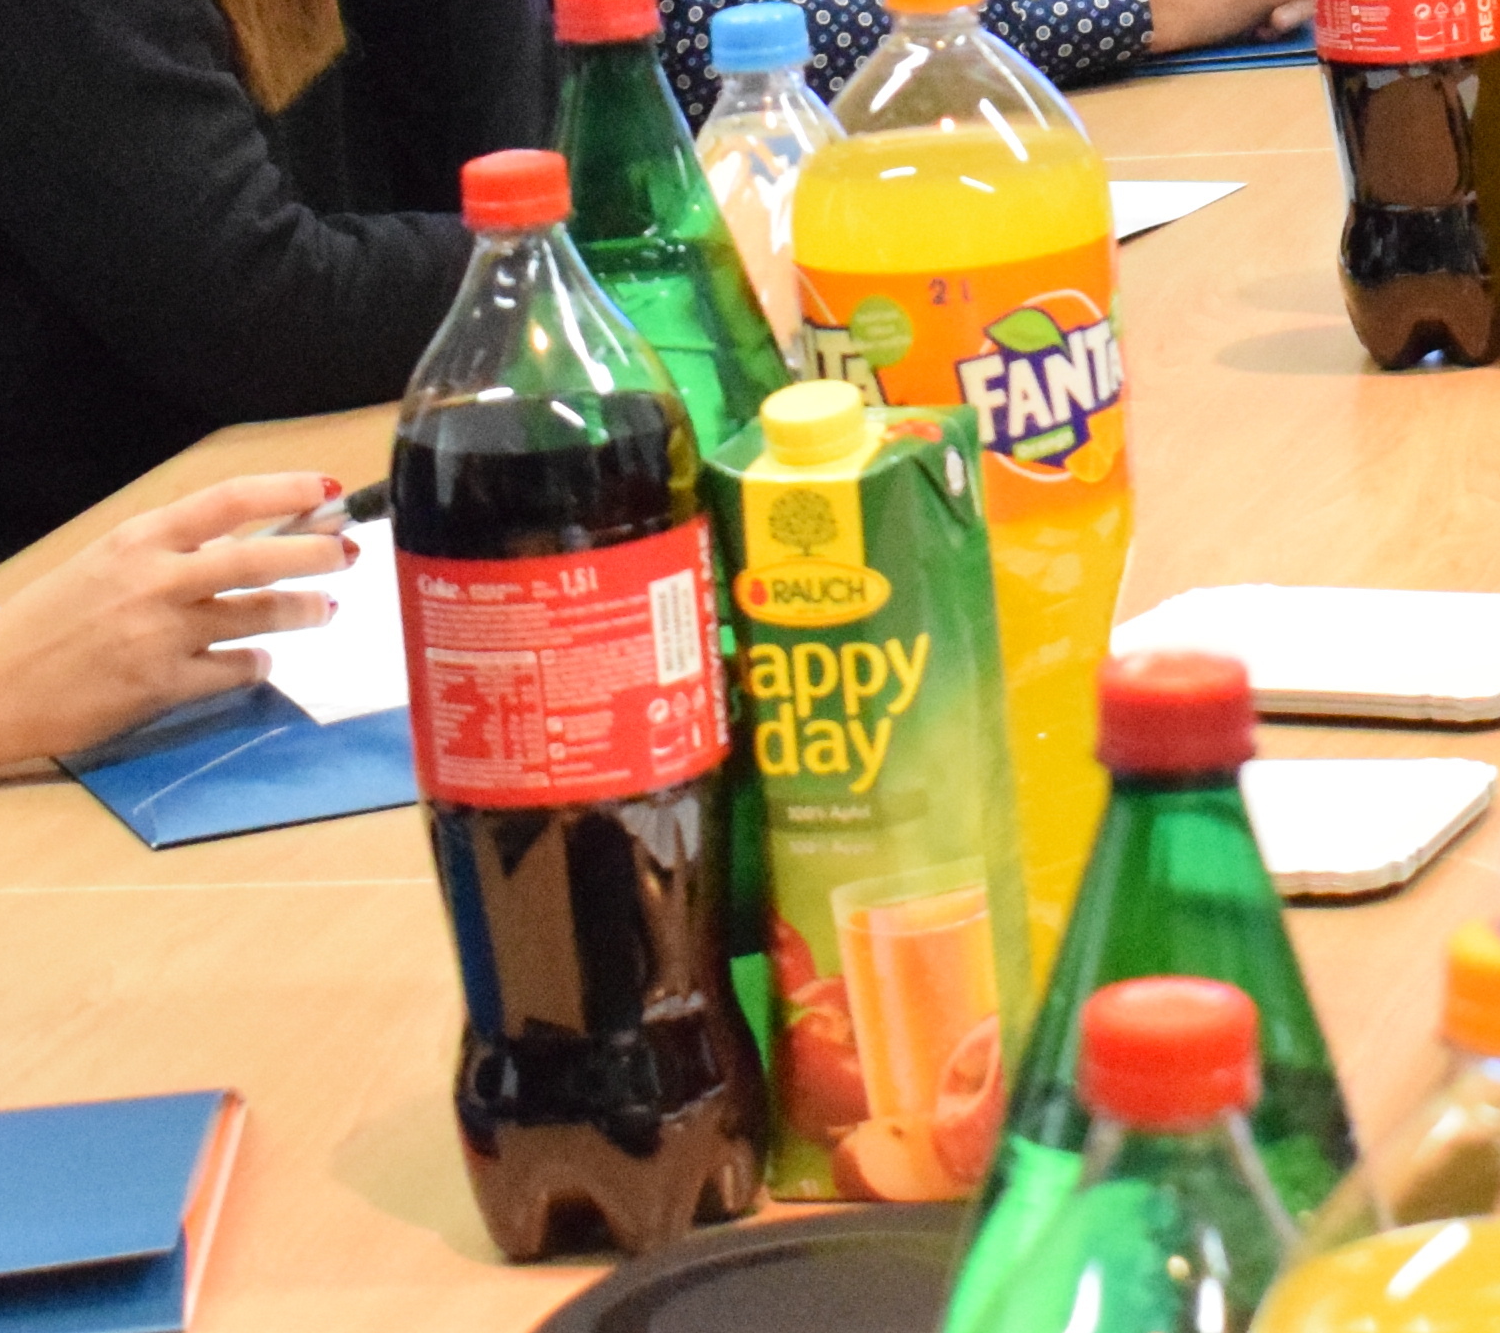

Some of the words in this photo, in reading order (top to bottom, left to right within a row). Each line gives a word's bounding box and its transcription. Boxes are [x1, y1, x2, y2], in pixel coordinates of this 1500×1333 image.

[929, 278, 947, 306] 2
[771, 577, 867, 605] RAUCH
[755, 701, 893, 794] day
